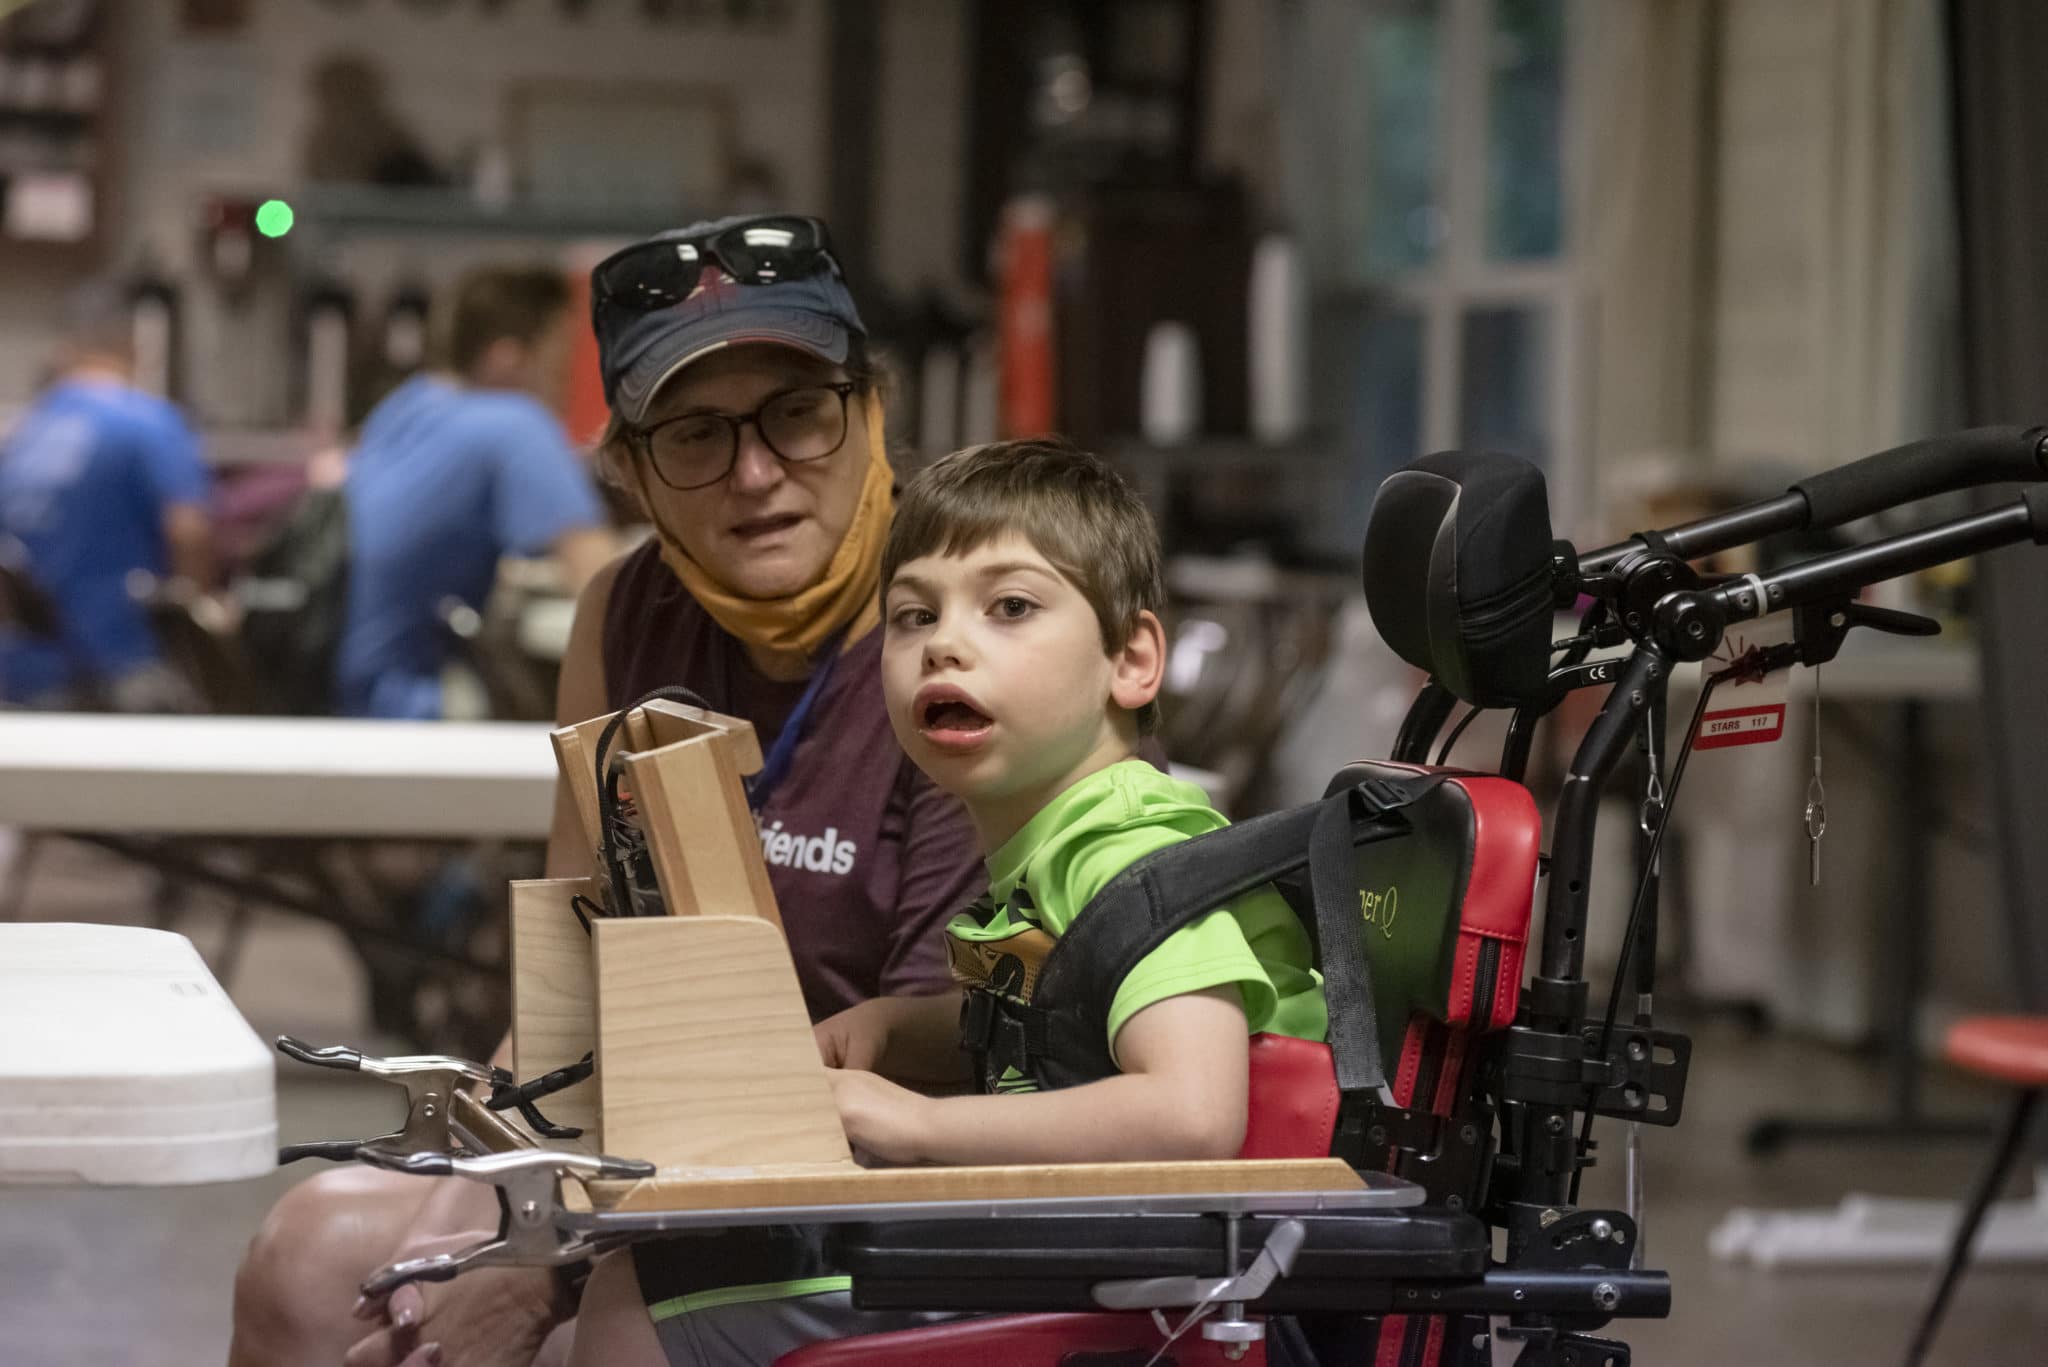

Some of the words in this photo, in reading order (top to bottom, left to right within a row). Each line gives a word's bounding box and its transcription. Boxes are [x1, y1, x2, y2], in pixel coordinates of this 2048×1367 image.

[1589, 666, 1606, 680] CE
[1710, 720, 1741, 733] STARS
[1751, 717, 1768, 728] 117
